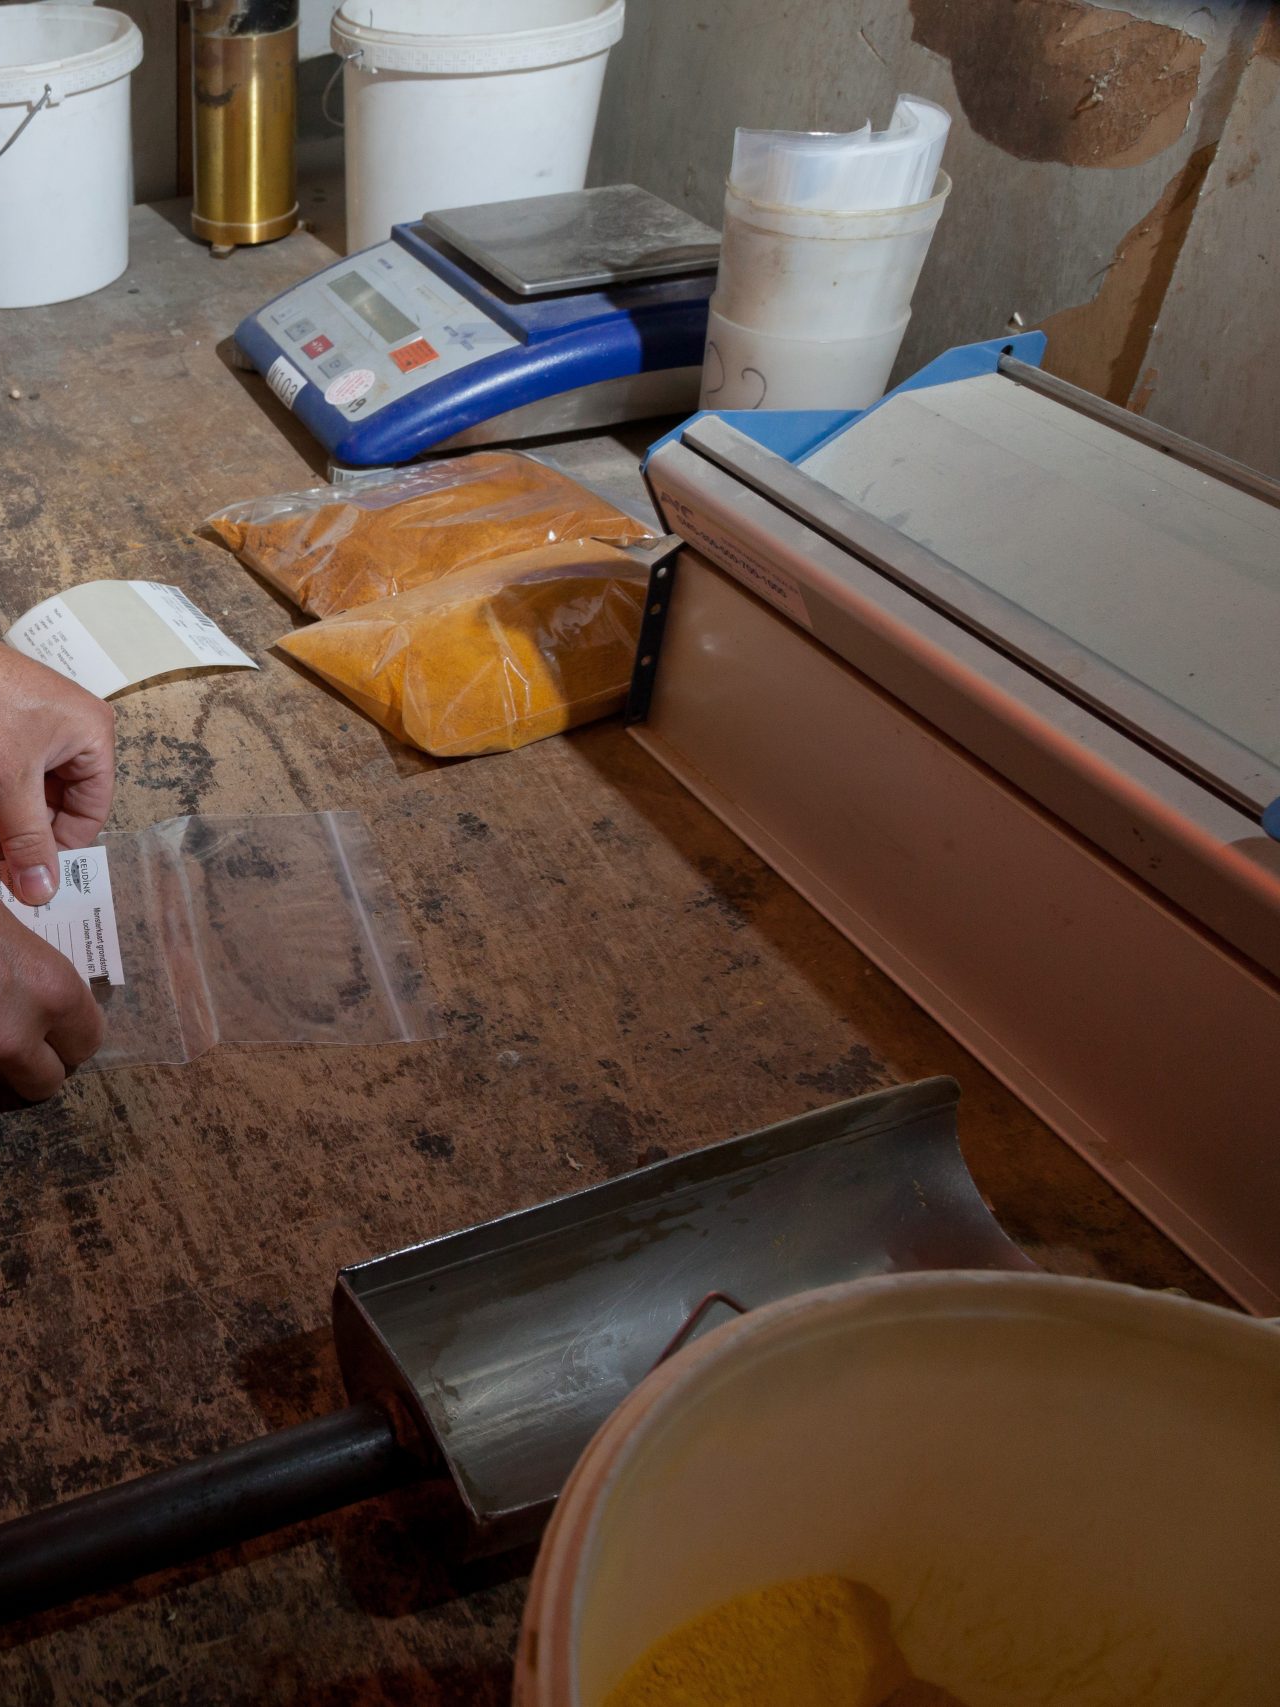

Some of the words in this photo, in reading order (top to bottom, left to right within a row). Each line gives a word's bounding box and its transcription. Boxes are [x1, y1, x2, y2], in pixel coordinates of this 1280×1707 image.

[64, 859, 72, 887] Product
[80, 858, 91, 895] REUDINK
[82, 919, 90, 940] Lochem
[93, 907, 104, 944] Monsterkaart
[85, 941, 94, 962] Reudink
